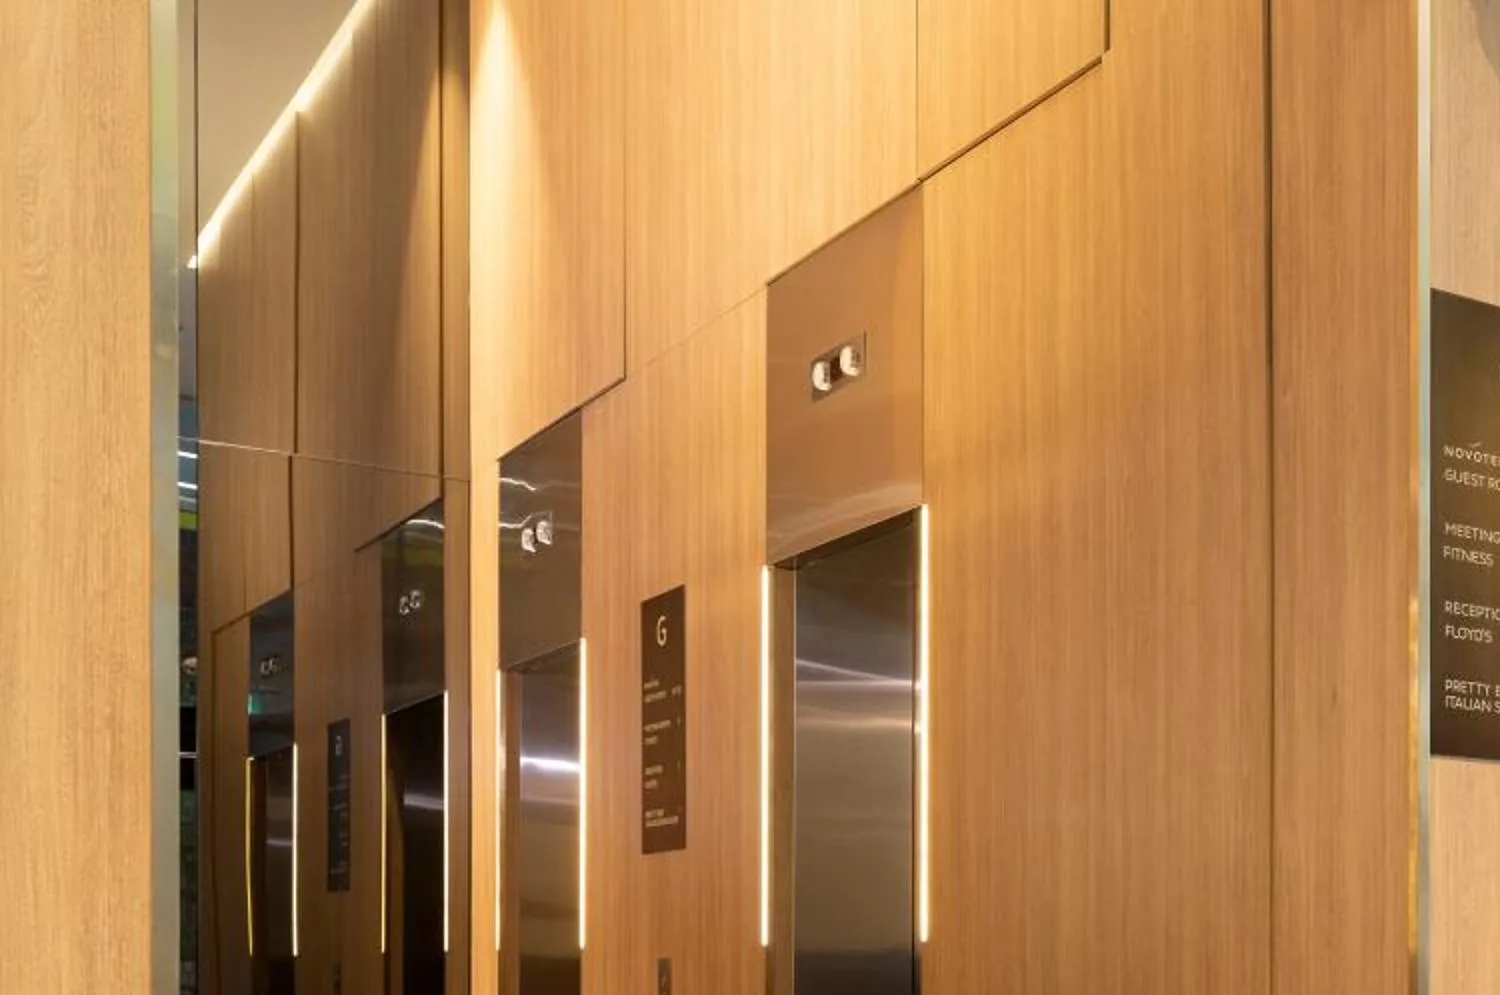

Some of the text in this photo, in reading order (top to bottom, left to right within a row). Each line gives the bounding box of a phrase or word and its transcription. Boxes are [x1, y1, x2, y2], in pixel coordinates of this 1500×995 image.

[1443, 468, 1485, 488] GUEST
[1444, 521, 1500, 544] MEETING
[1443, 545, 1494, 568] FITNESS
[657, 615, 667, 647] G
[1445, 624, 1493, 644] FLOYD'S
[1444, 679, 1490, 698] PRETTY
[1445, 695, 1492, 714] ITALIAN
